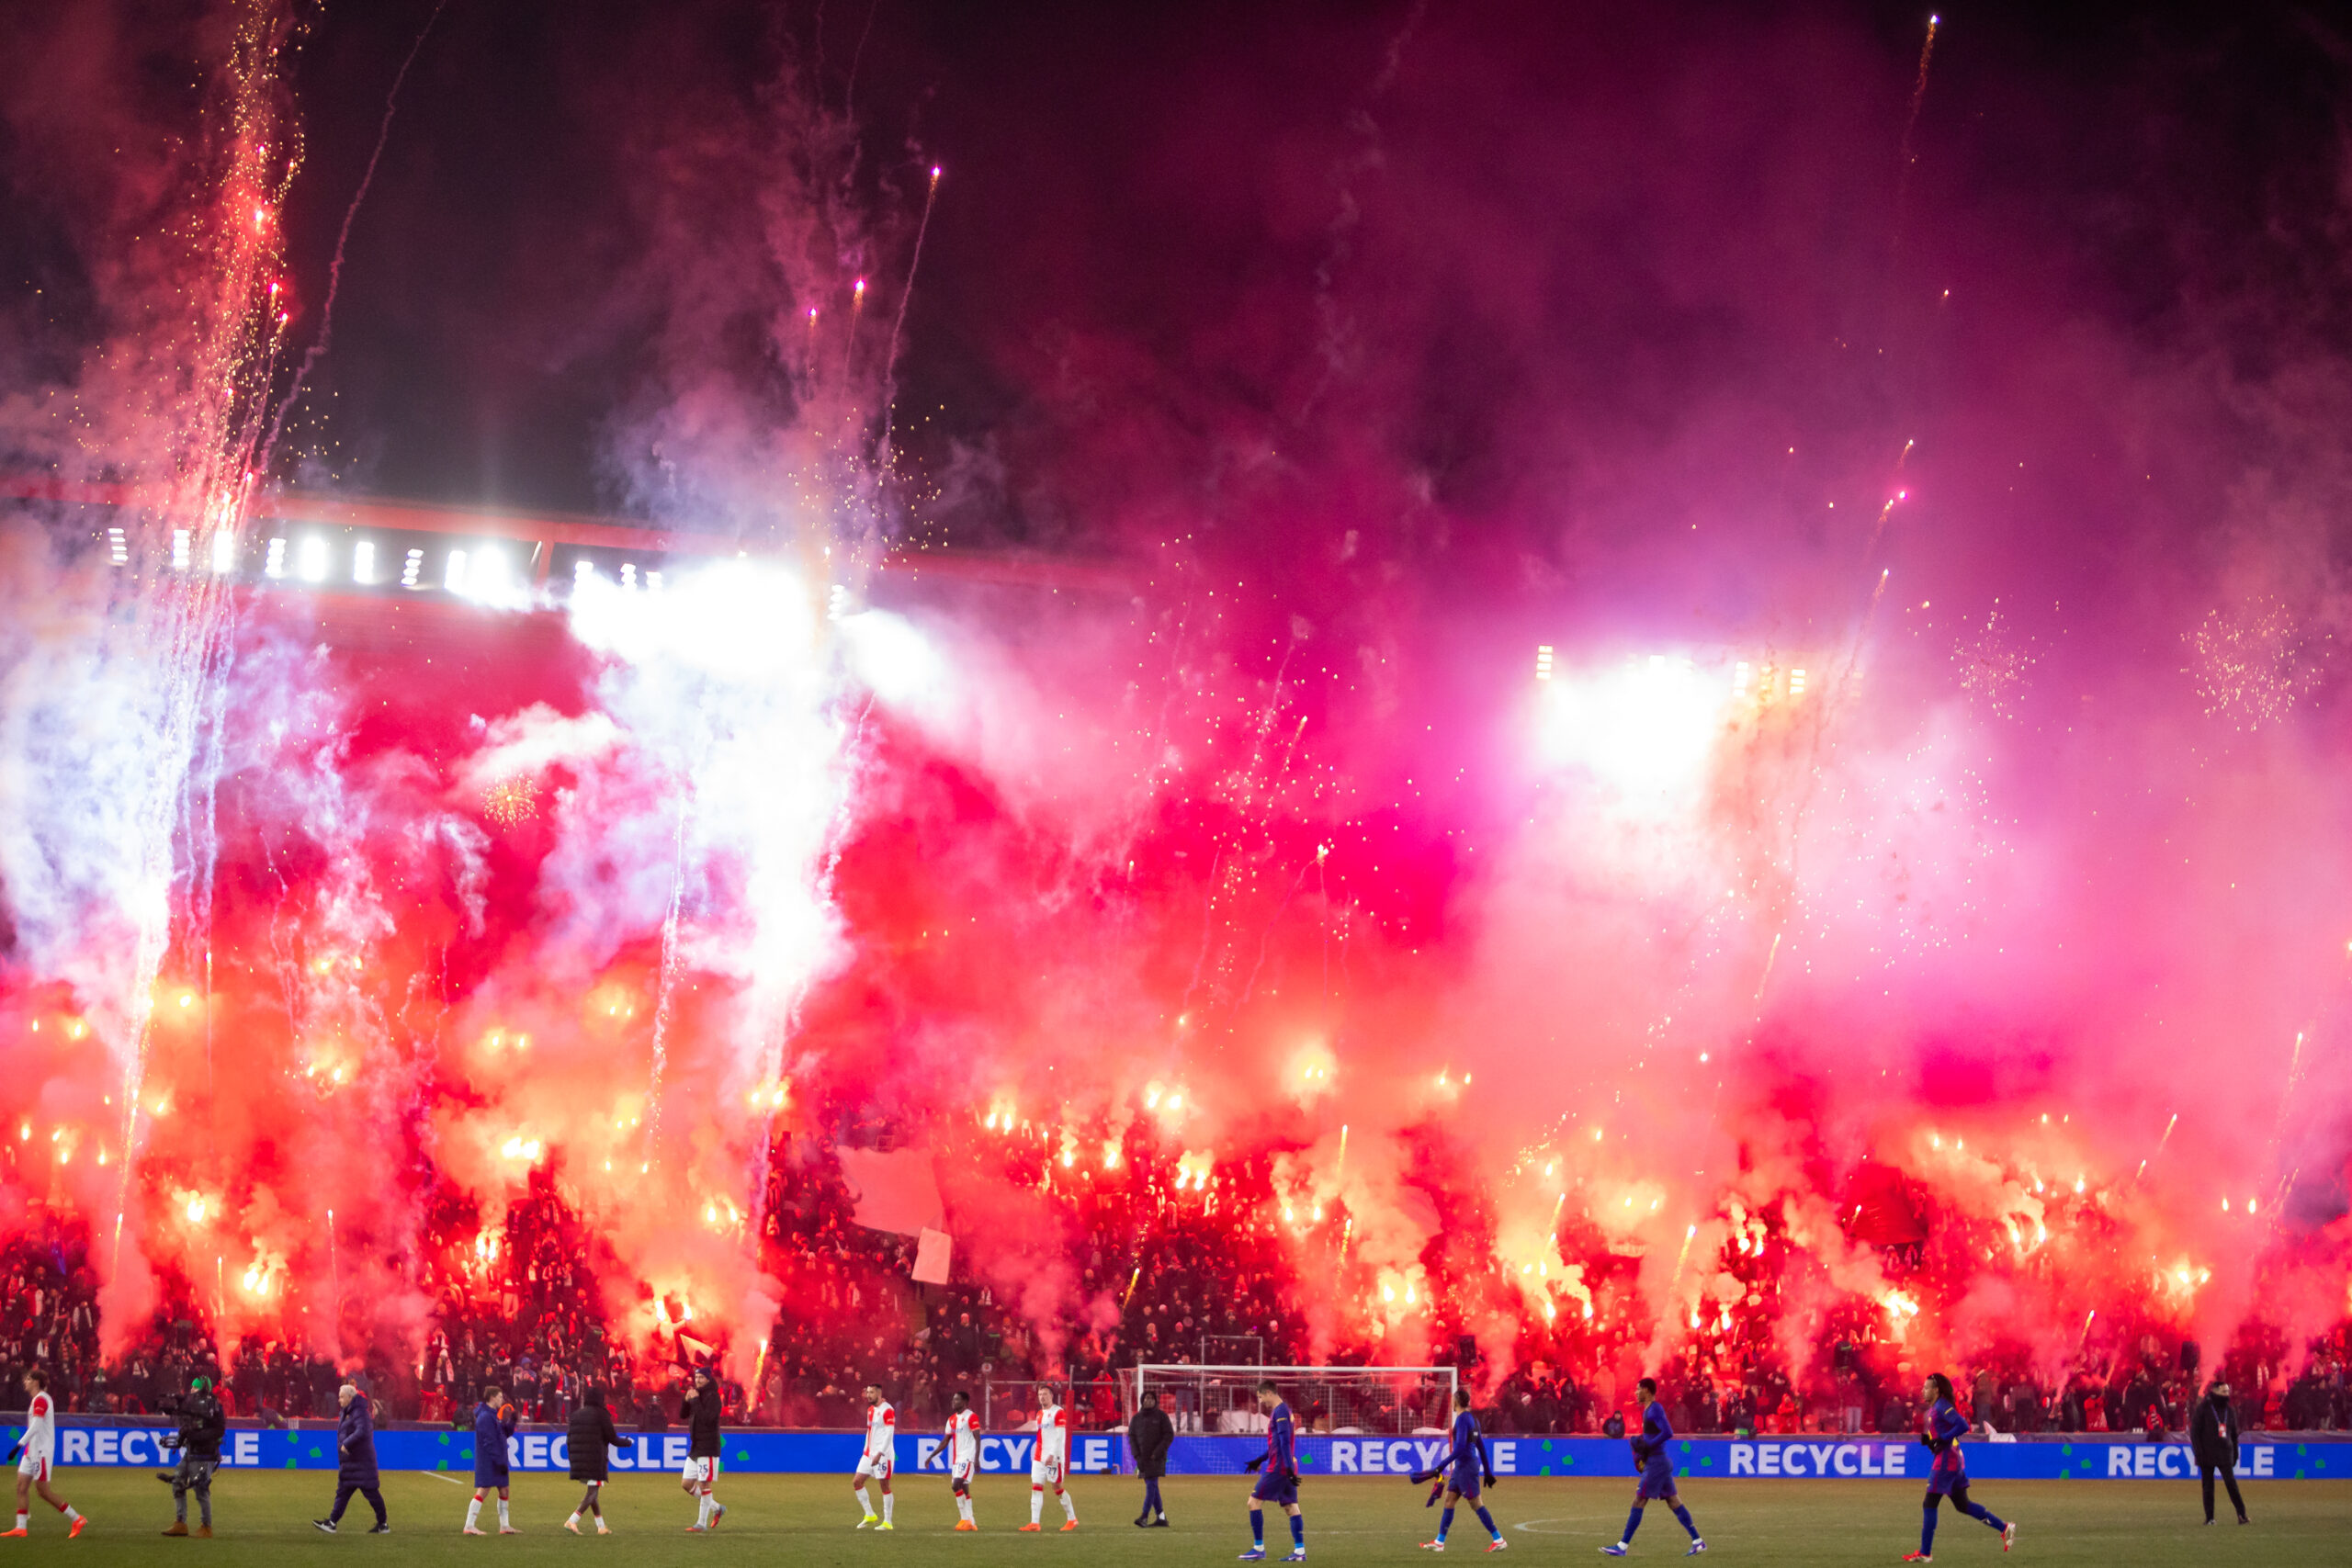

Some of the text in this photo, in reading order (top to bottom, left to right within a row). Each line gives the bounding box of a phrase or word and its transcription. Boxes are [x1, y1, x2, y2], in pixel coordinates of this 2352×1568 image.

[62, 1429, 259, 1465] RECYE
[507, 1435, 687, 1469] RECCLE
[1332, 1440, 1516, 1472] RECYE
[1729, 1443, 1906, 1475] RECYCLE
[698, 1464, 708, 1473] 25
[1047, 1466, 1057, 1476] 27
